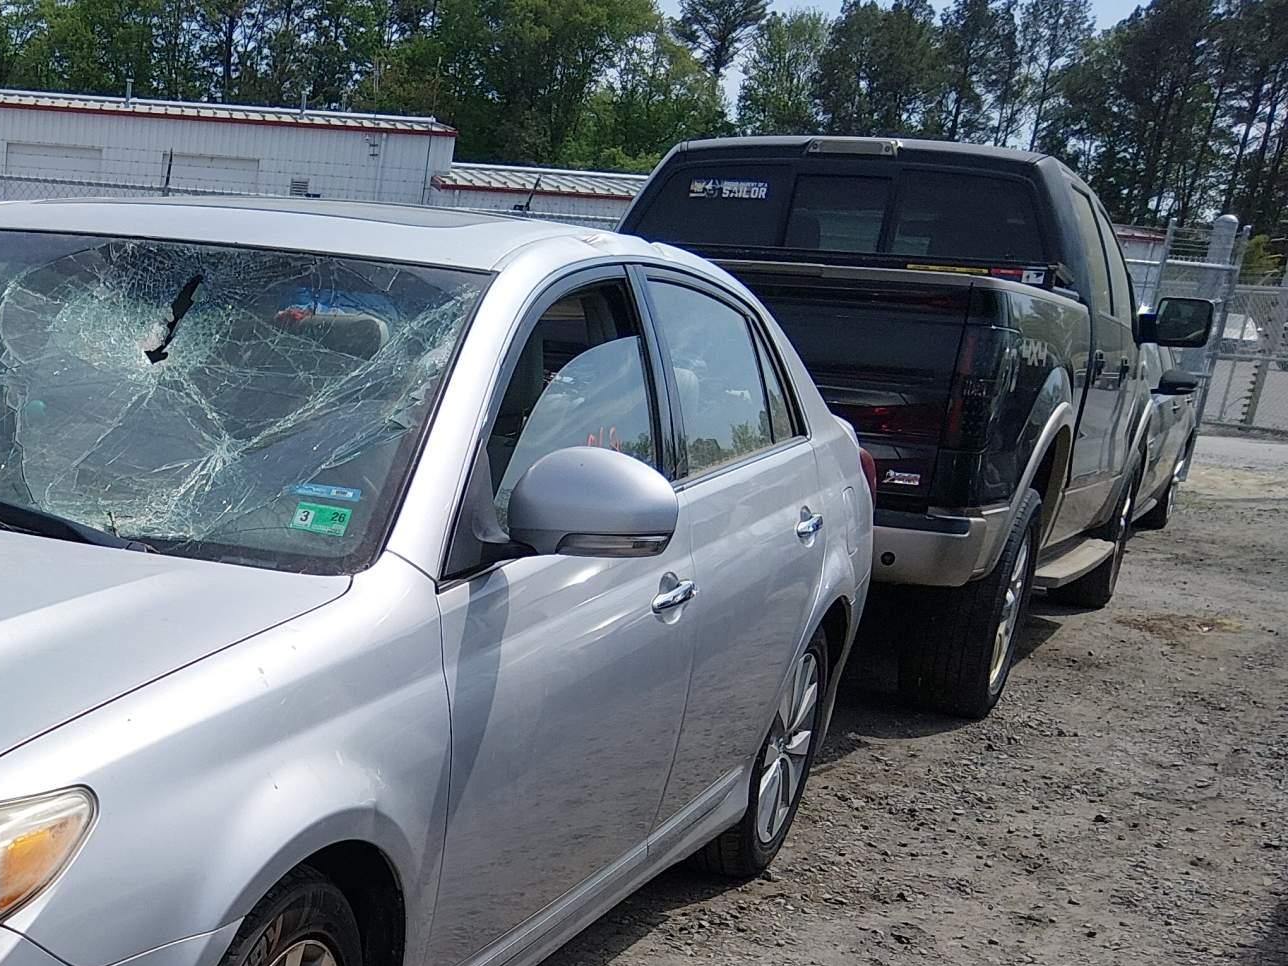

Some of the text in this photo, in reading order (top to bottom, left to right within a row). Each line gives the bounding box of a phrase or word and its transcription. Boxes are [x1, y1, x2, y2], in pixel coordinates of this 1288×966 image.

[722, 186, 767, 199] SAILOR
[299, 510, 310, 522] 3
[331, 511, 347, 523] 26
